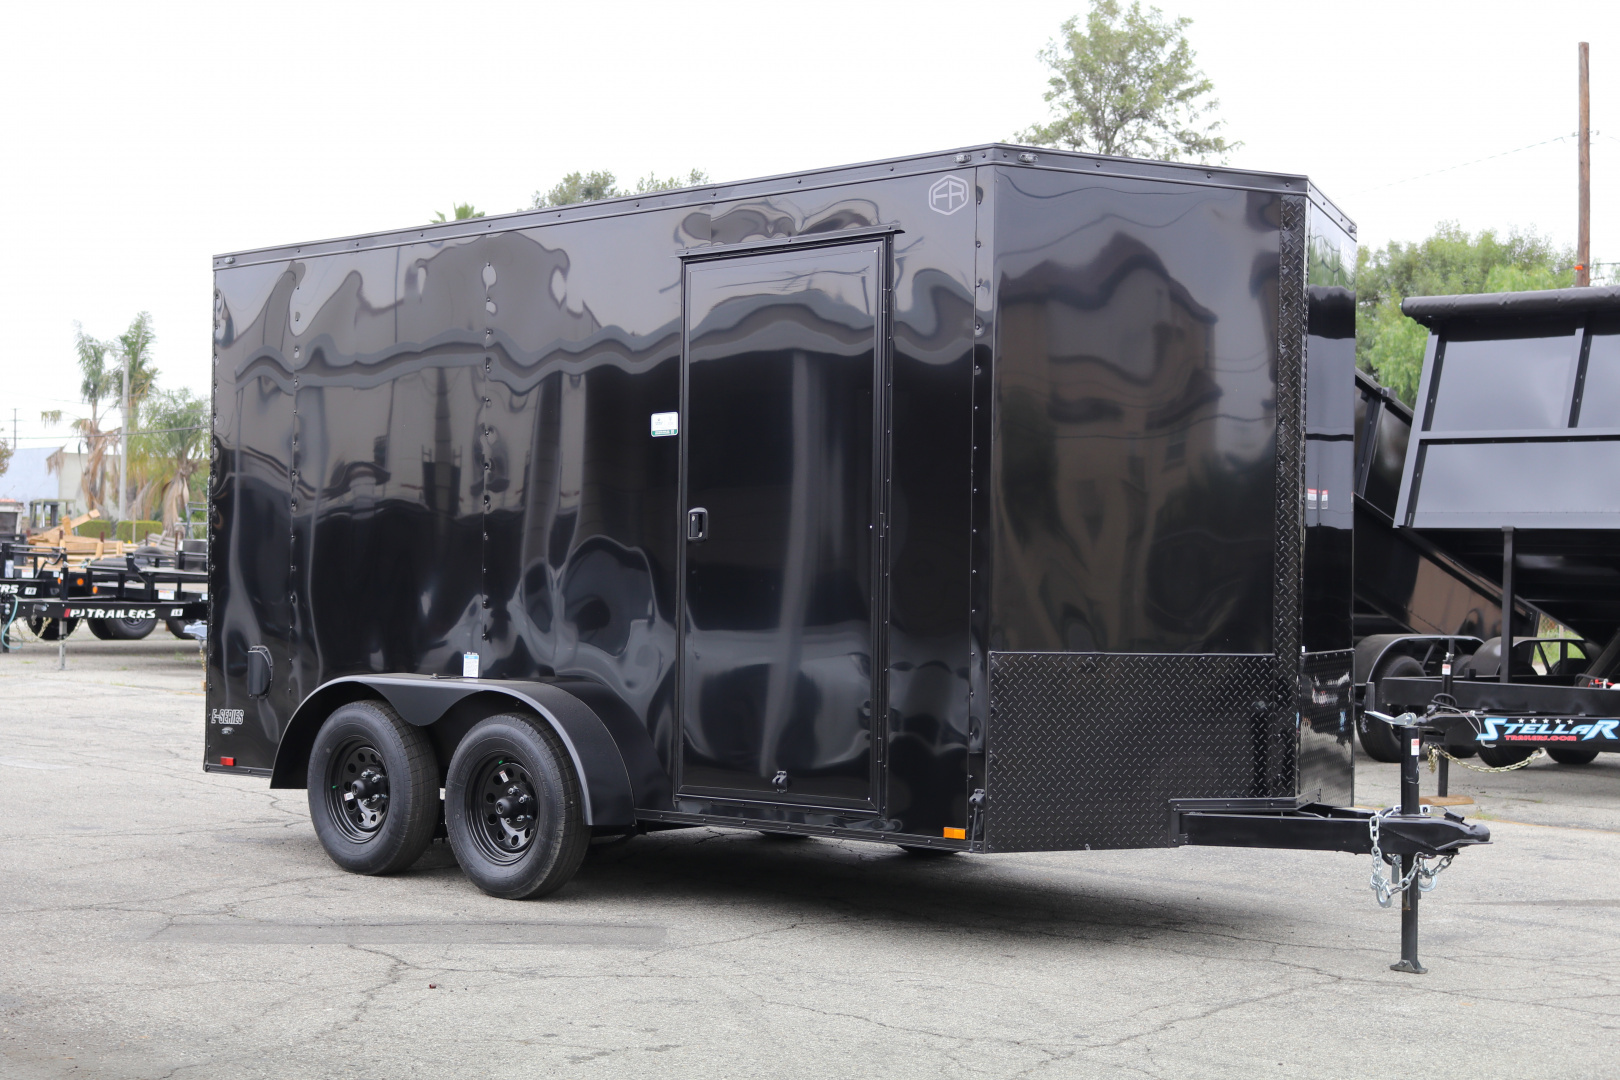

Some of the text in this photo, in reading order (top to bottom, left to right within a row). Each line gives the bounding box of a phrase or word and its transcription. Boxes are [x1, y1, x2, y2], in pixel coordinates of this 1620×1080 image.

[0, 584, 19, 593] RS
[70, 608, 156, 618] PJ TRAILERS
[211, 708, 244, 725] E-SERIES
[1475, 718, 1620, 740] STELLAR
